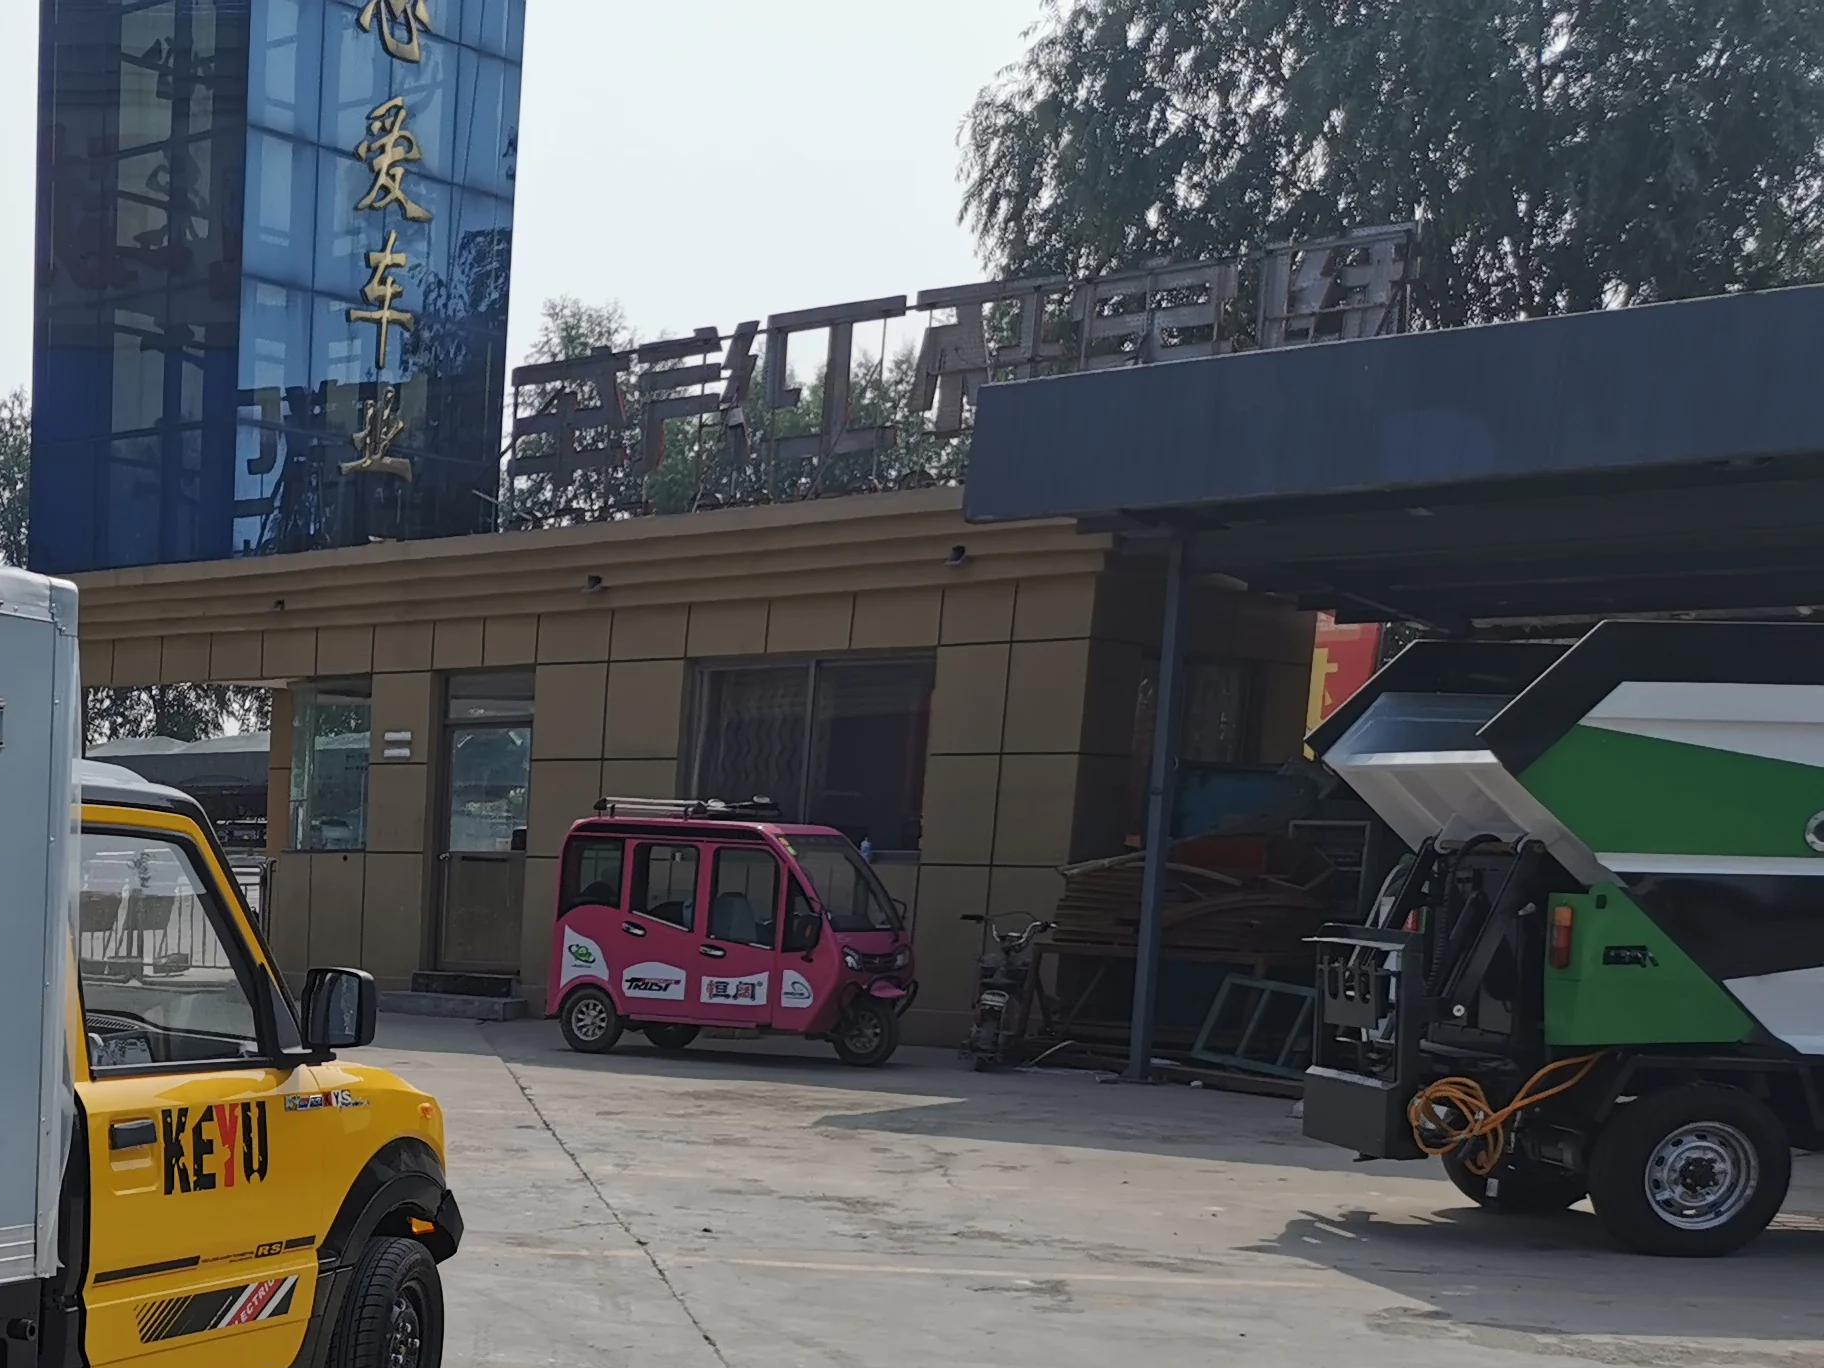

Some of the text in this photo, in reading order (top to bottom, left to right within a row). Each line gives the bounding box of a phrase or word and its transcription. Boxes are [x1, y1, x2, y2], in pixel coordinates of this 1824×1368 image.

[625, 977, 681, 993] TRUST
[161, 1101, 269, 1195] KEYU
[257, 1243, 282, 1256] RS
